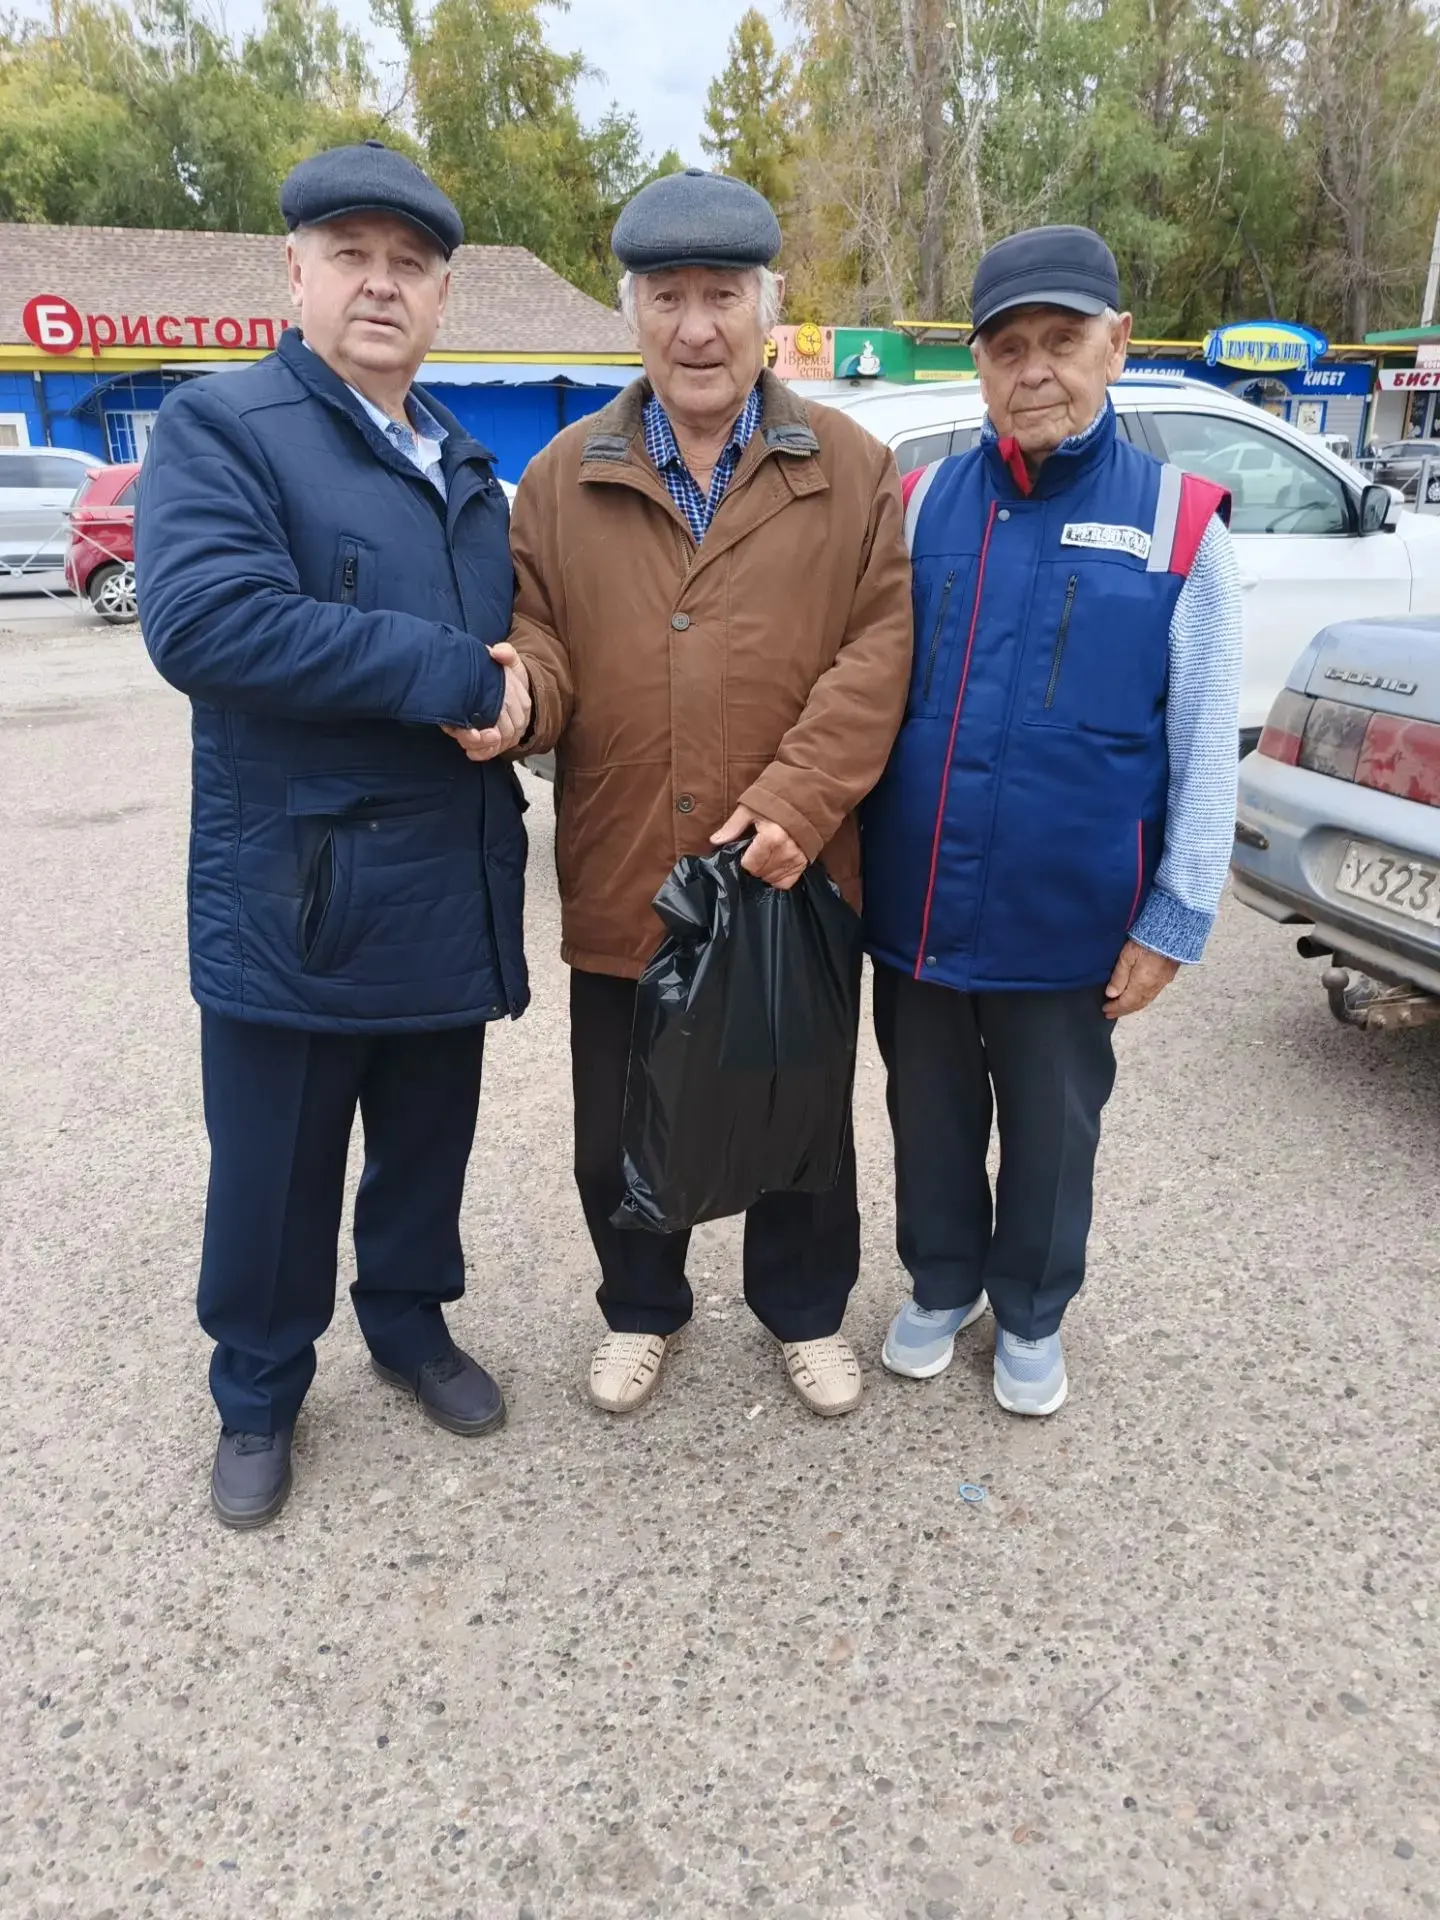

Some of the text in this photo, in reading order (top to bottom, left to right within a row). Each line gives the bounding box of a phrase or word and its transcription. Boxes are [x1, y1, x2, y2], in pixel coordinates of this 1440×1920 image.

[788, 351, 828, 370] Время
[800, 366, 831, 378] есть
[1303, 371, 1346, 387] КИБЕТ
[1350, 857, 1440, 918] У323
